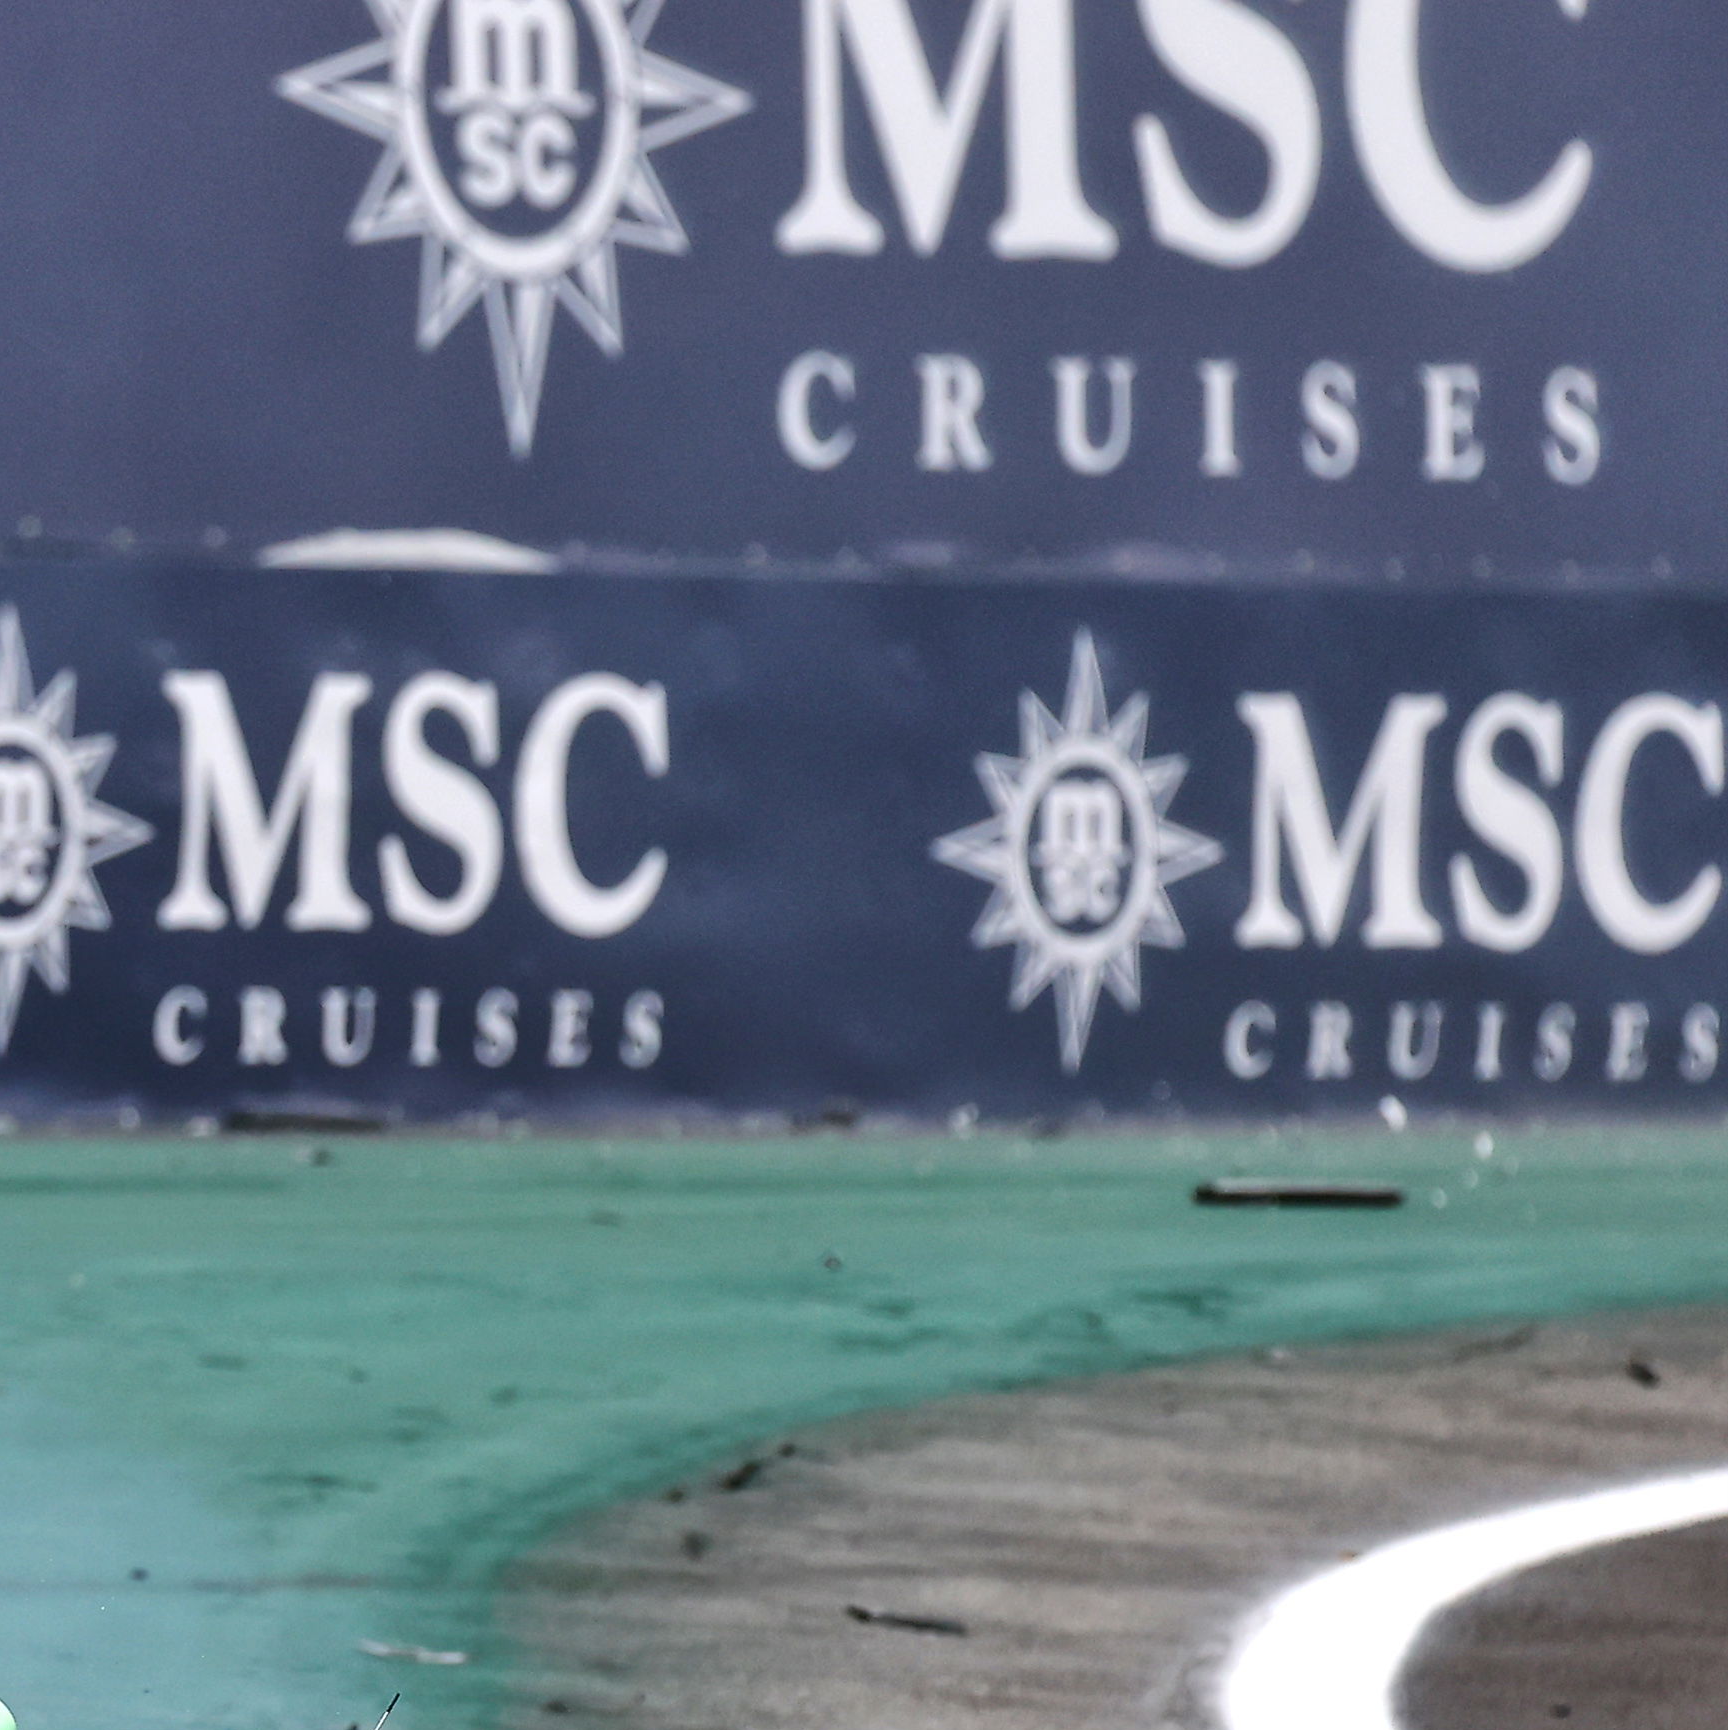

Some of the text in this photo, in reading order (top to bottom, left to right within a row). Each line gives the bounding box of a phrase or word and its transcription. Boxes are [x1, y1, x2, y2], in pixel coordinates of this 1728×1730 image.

[778, 0, 1593, 272] MSC
[777, 353, 1602, 484] CRUISES
[160, 671, 668, 936] MSC
[1236, 692, 1726, 954] MSC
[153, 987, 665, 1067] CRUISES
[1224, 1002, 1721, 1082] CRUISES
